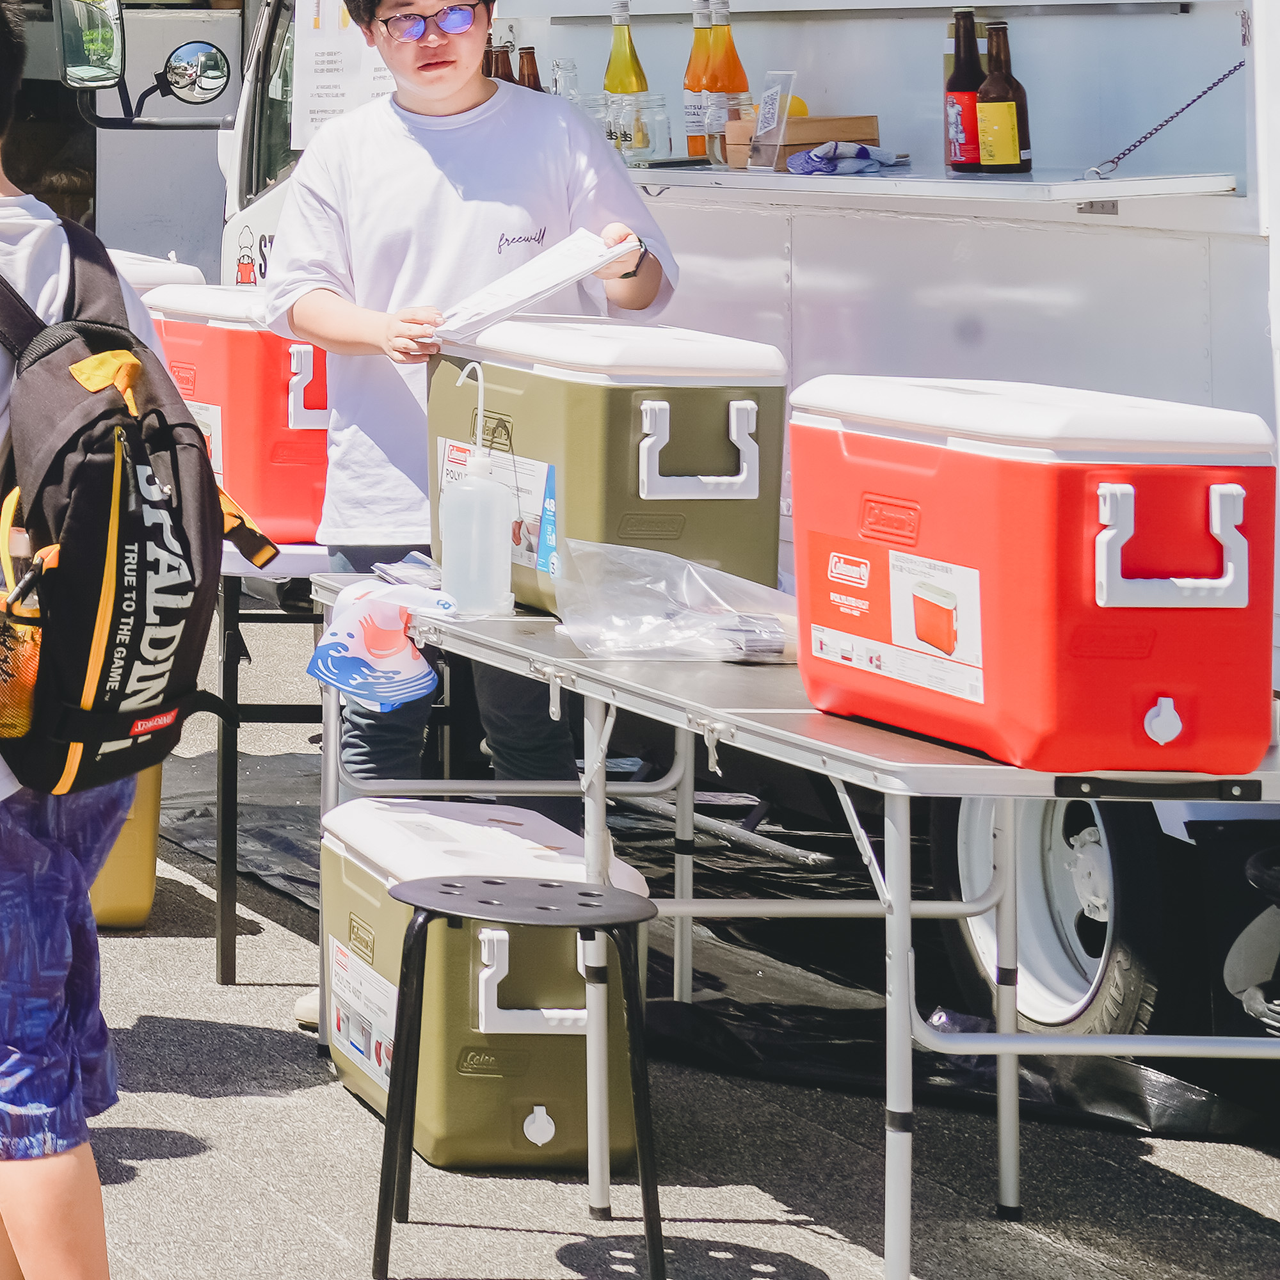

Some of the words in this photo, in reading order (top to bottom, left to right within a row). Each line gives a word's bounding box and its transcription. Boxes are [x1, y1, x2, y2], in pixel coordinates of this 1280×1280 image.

[123, 542, 138, 590] TRUE
[121, 593, 136, 612] TO
[116, 615, 134, 644] THE
